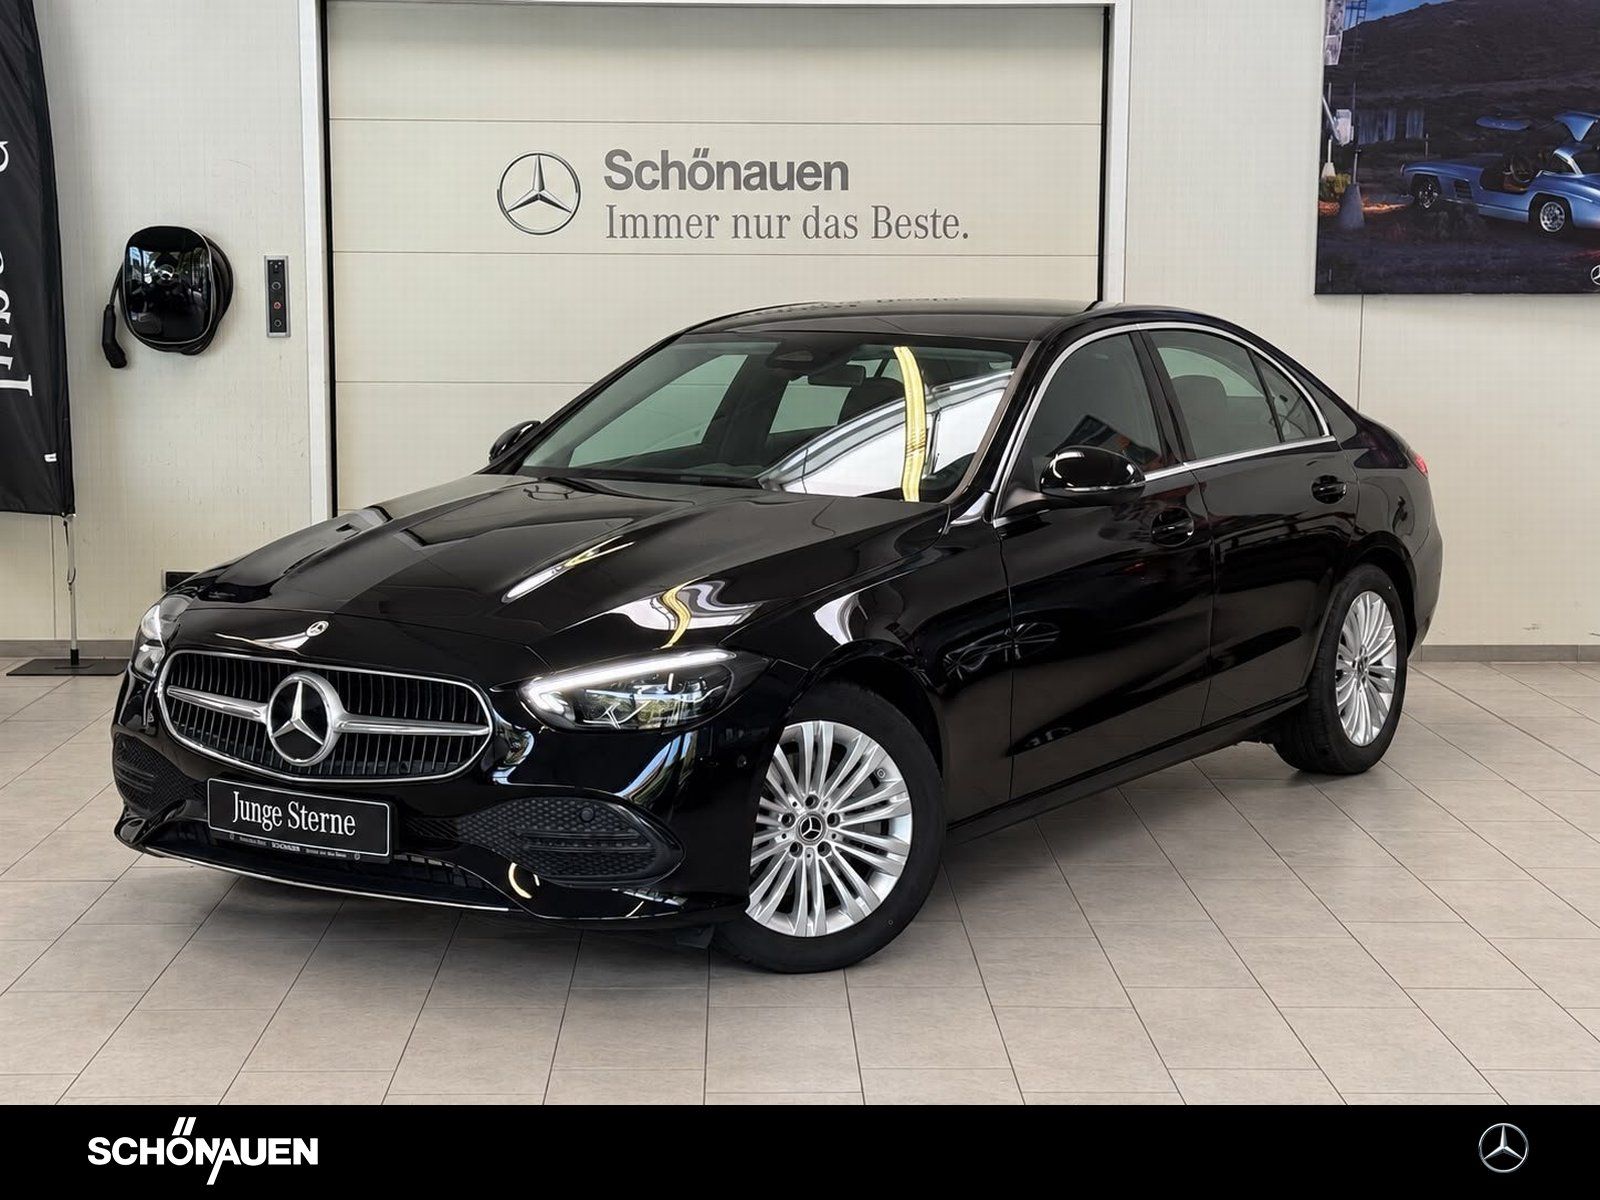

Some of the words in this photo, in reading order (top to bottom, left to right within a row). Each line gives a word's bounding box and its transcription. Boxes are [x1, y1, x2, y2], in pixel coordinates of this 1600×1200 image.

[604, 147, 849, 192] Schönauen
[605, 204, 720, 240] Immer
[731, 212, 792, 240] nur
[802, 205, 860, 240] das
[871, 204, 969, 240] Beste.
[232, 791, 283, 832] Junge
[288, 801, 356, 836] Sterne
